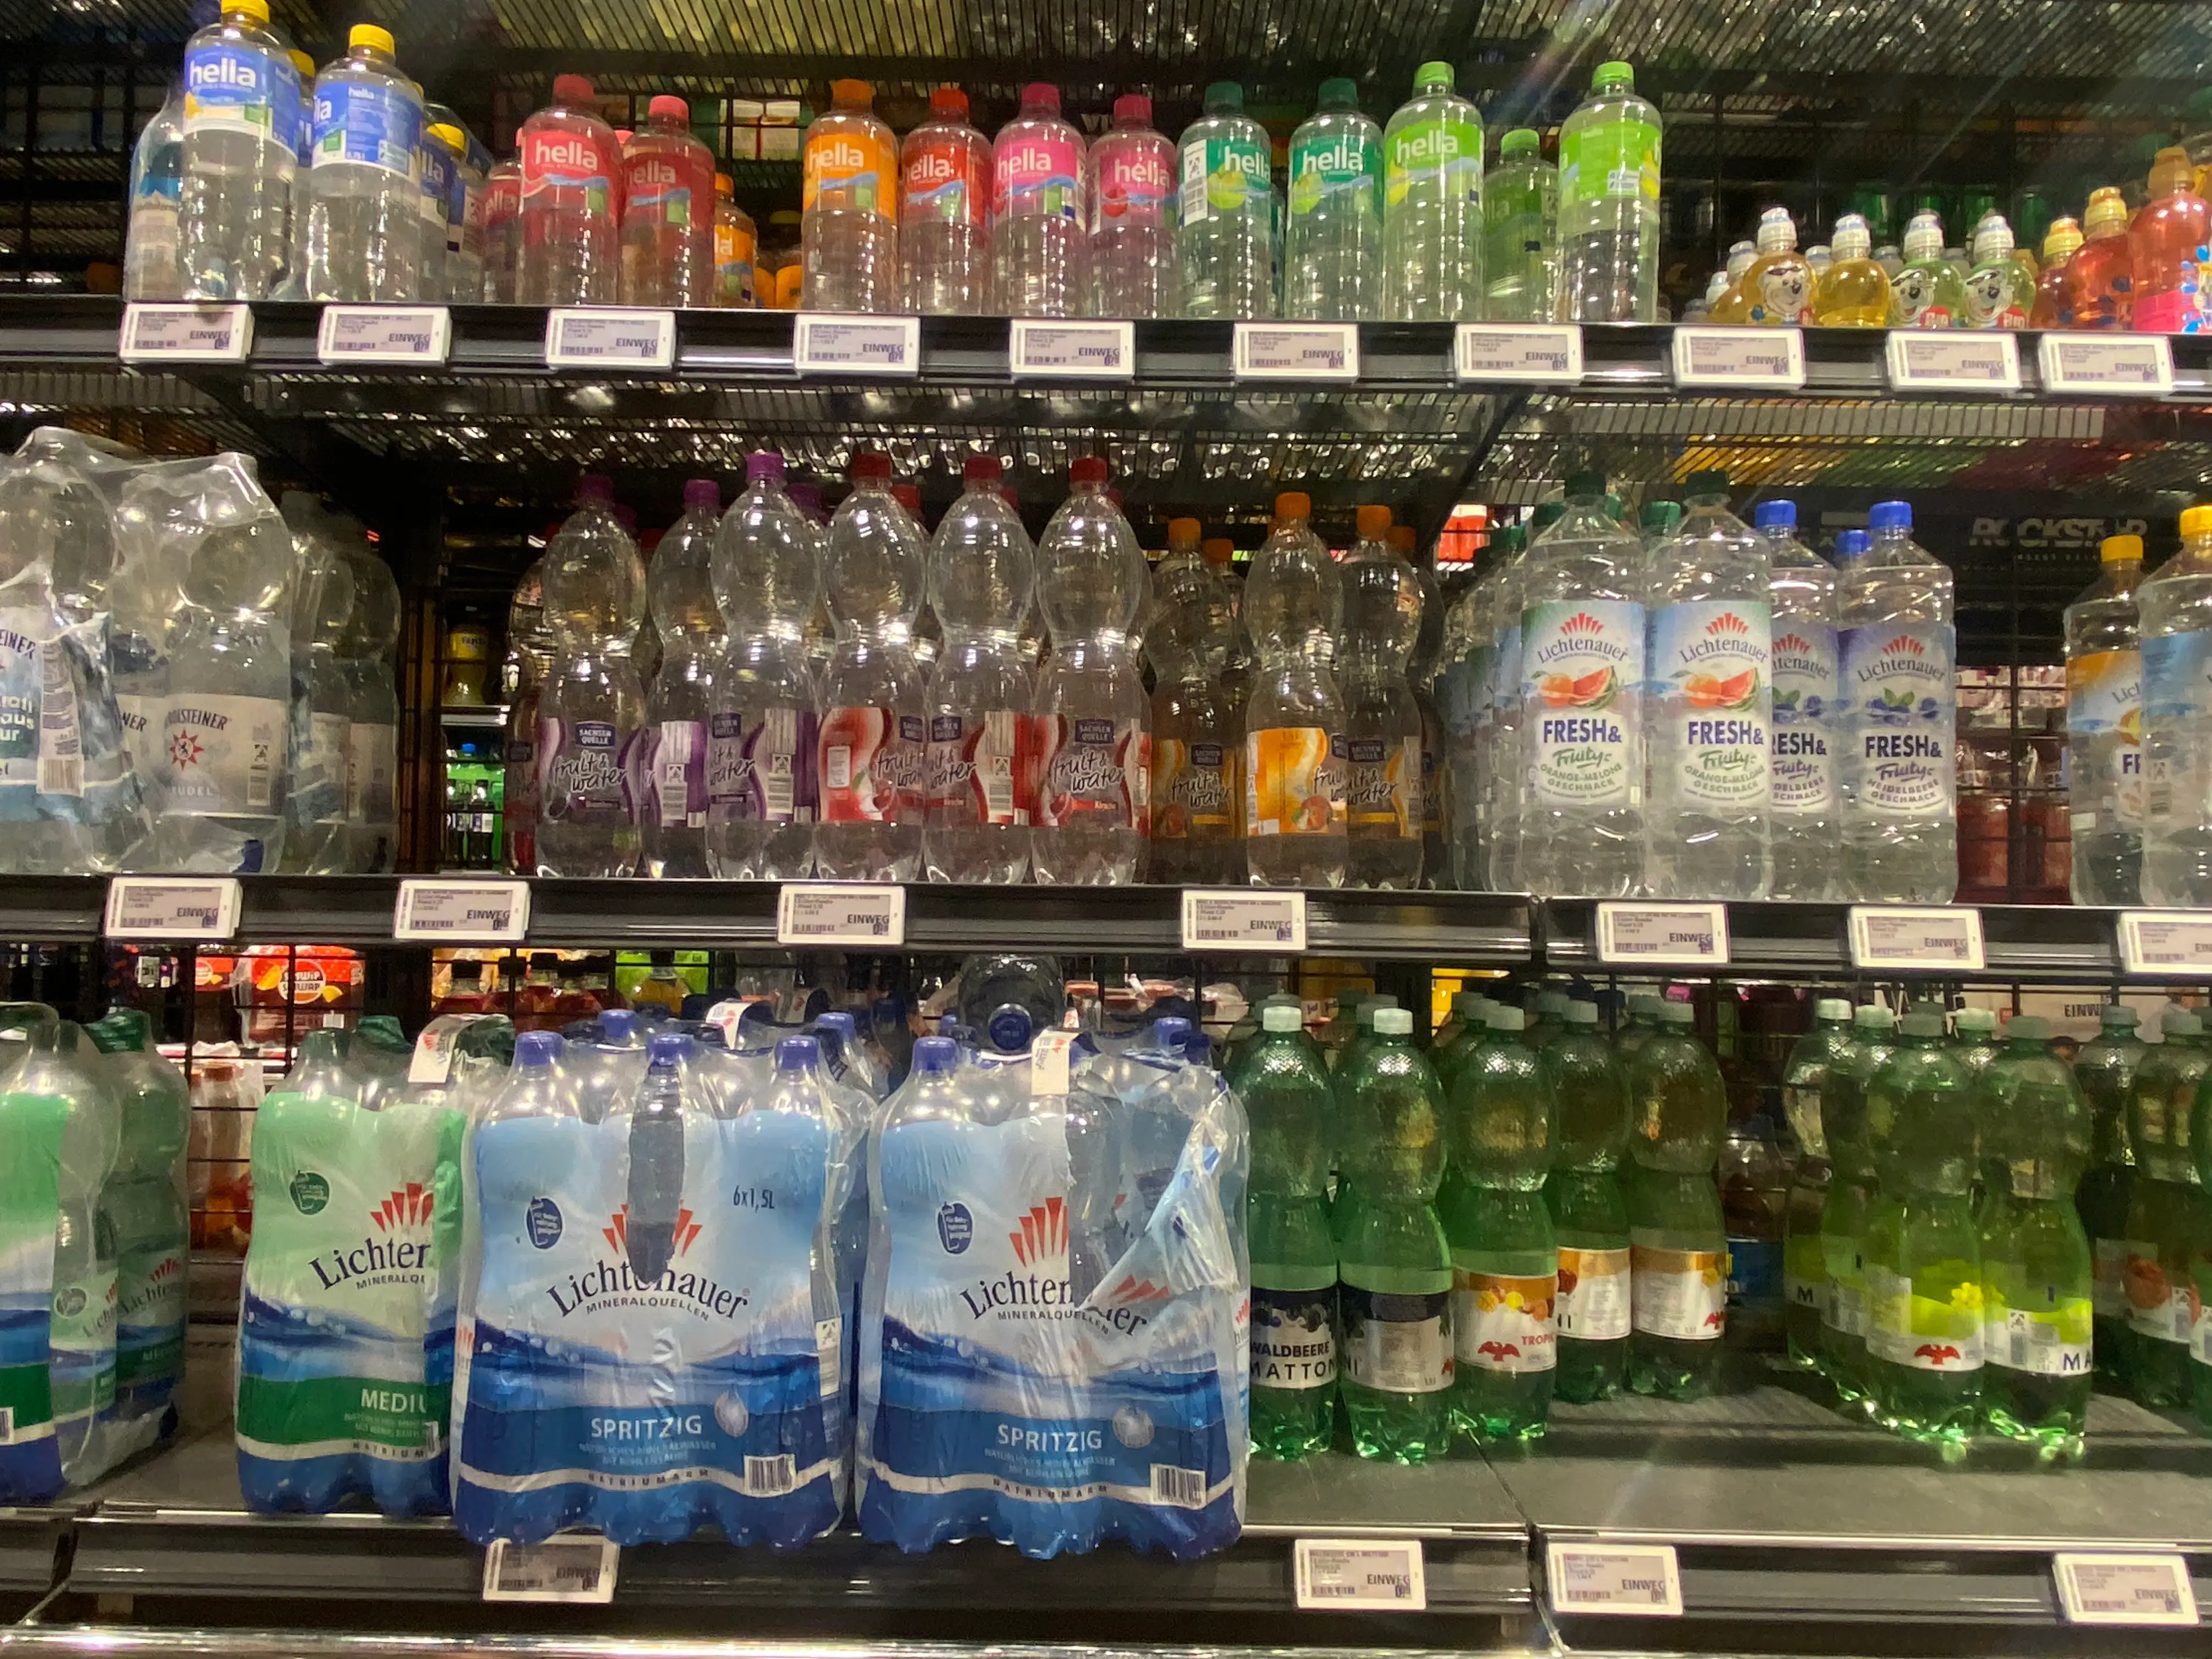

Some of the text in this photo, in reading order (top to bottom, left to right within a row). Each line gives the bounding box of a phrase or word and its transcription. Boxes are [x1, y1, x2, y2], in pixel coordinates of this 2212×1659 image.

[189, 58, 256, 88] hella
[535, 139, 599, 171] hella
[809, 142, 864, 173] hella
[1397, 129, 1459, 163] hella
[905, 154, 951, 181] ella
[997, 148, 1052, 180] hella
[1224, 145, 1271, 179] hella
[1302, 145, 1363, 174] hella
[1114, 159, 1170, 189] hella
[389, 332, 430, 342] EINWEG
[616, 338, 657, 347] EINWEG
[862, 343, 904, 353] EINWEG
[1079, 347, 1120, 357] EINWEG
[1302, 349, 1344, 359] EINWEG
[1525, 352, 1568, 361] EINWEG
[1746, 356, 1788, 364] EINWEG
[1537, 635, 1629, 664] Lichtenauer
[1679, 635, 1770, 664] Lichtenauer
[1858, 659, 1945, 682] Lichtenauer
[167, 709, 228, 731] STEINER
[1543, 718, 1623, 744] FRESH&
[1688, 720, 1764, 745] FRESH&
[1773, 732, 1827, 755] ESH&
[1865, 735, 1943, 759] FRESH&
[572, 768, 628, 792] water
[1071, 767, 1125, 792] water
[467, 910, 511, 920] EINWEG
[847, 913, 889, 924] EINWEG
[1250, 919, 1292, 930] EINWEG
[1669, 933, 1713, 943] EINWEG
[1924, 938, 1968, 948] EINWEG
[283, 983, 321, 991] SWAP
[586, 1297, 709, 1322] MINERALQUELLEN
[591, 1414, 703, 1441] SPRITZIG
[997, 1423, 1102, 1453] SPRITZIG
[1367, 1573, 1410, 1585] EINWEG
[1621, 1579, 1666, 1592] EINWEG
